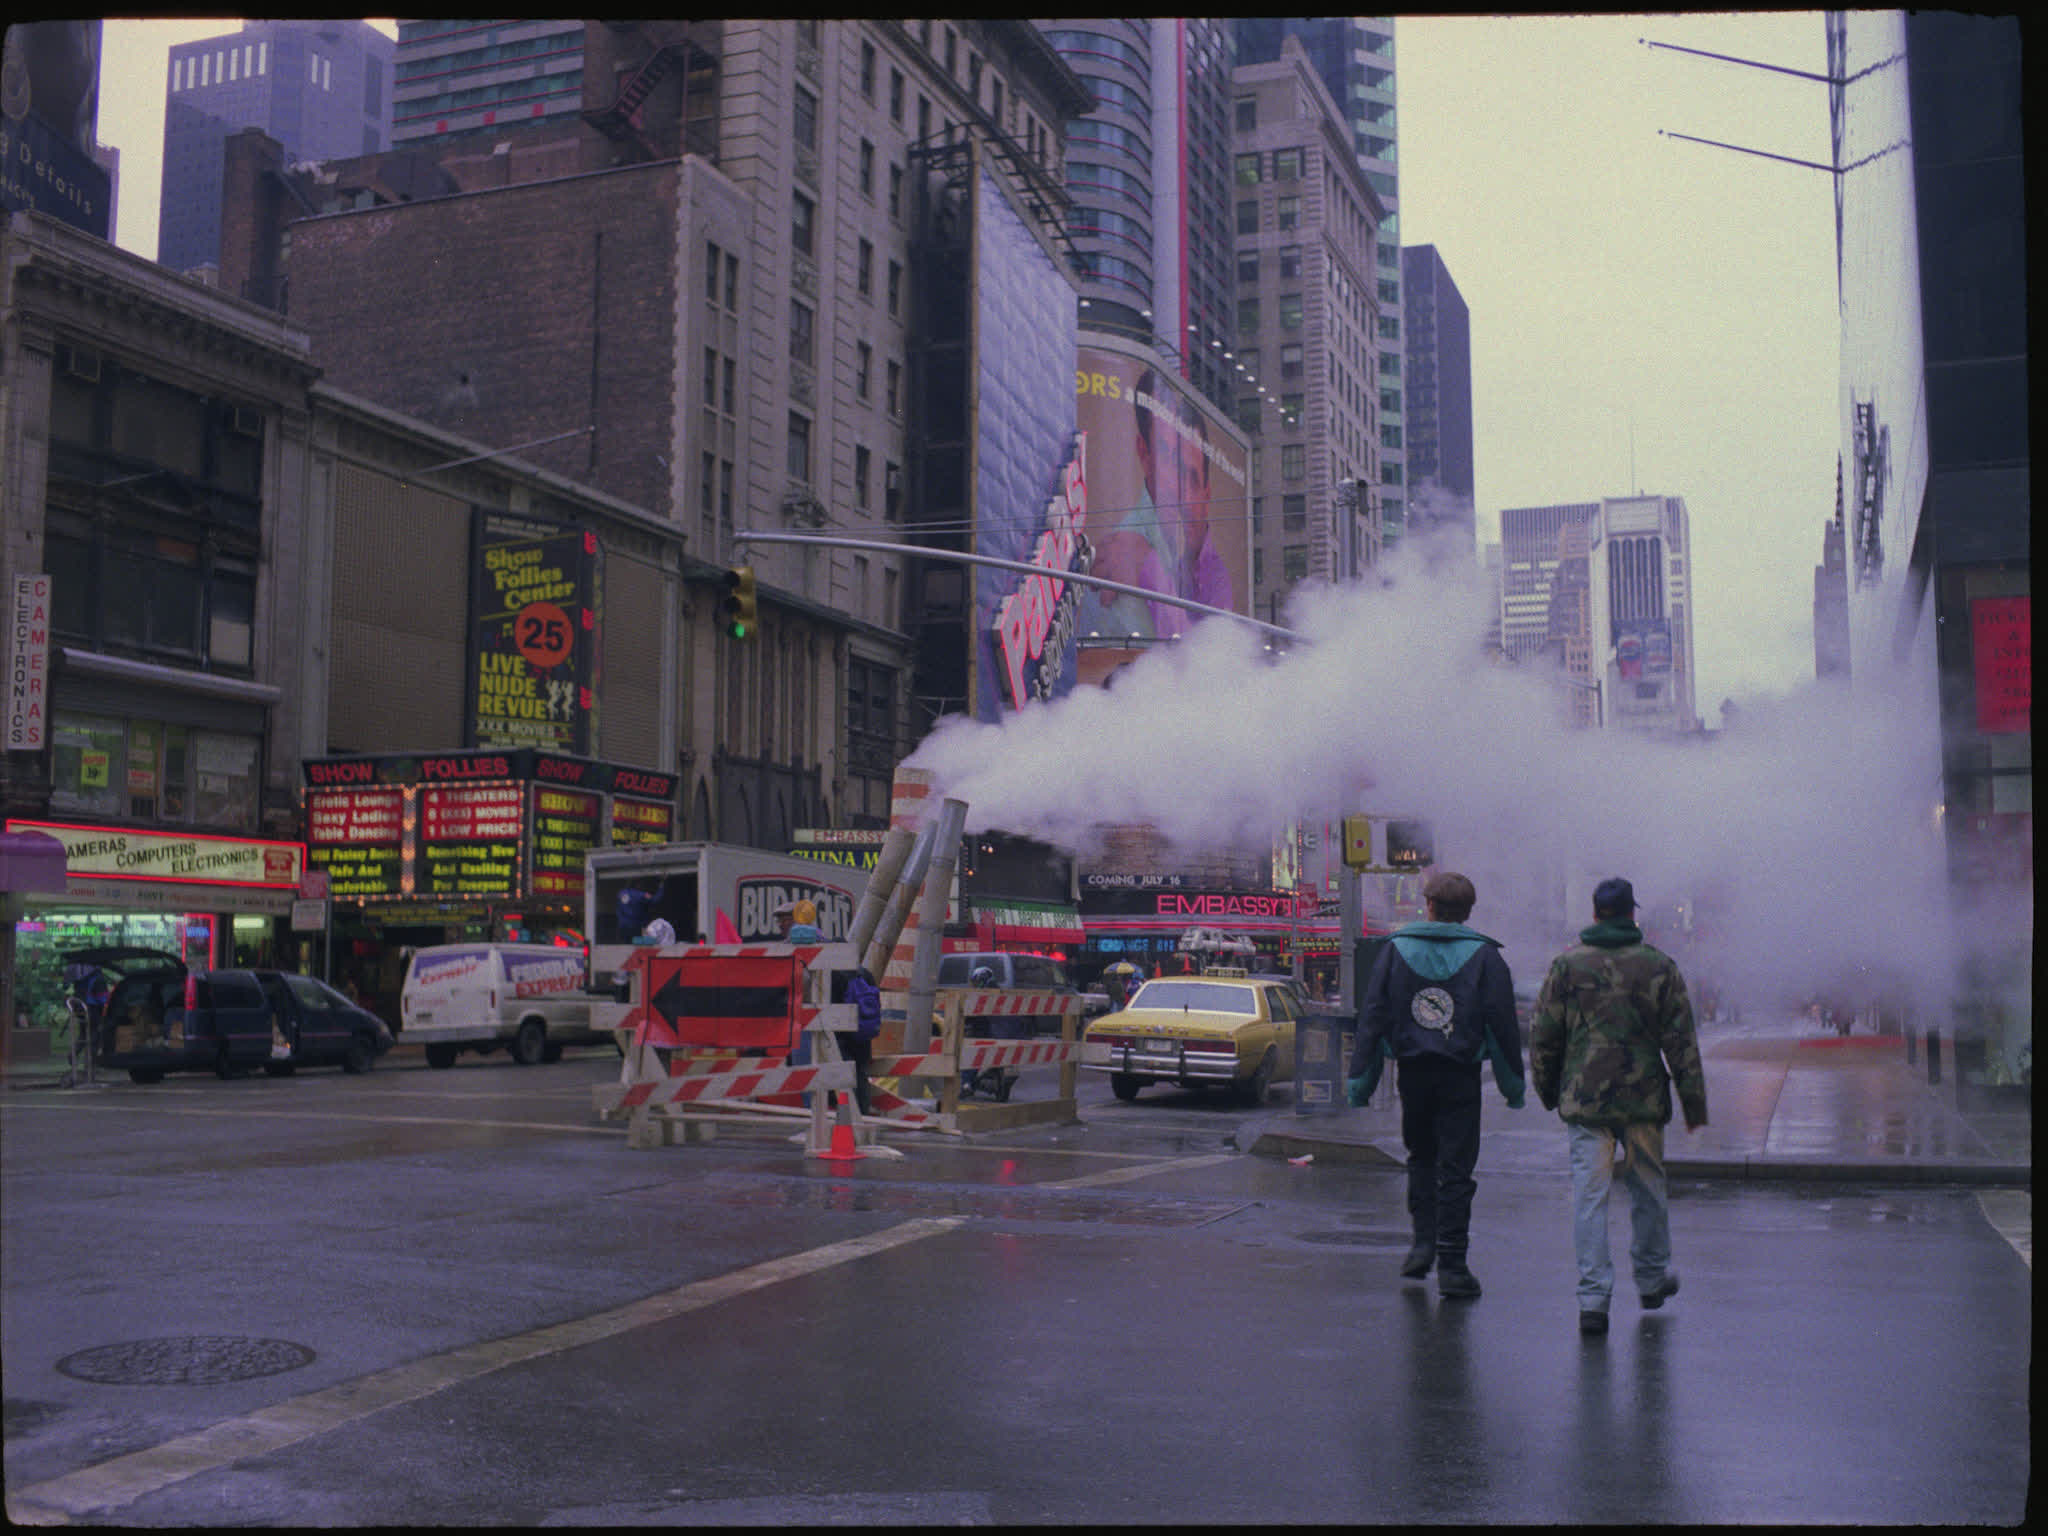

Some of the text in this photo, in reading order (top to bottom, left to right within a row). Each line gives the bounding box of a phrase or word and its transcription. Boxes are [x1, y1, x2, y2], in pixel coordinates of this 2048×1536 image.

[485, 548, 543, 571] Show
[494, 565, 562, 591] Follies
[504, 582, 575, 610] Center
[523, 618, 563, 651] 25
[12, 580, 30, 743] ELECTRONICS
[28, 580, 46, 743] CAMERAS
[479, 652, 526, 677] LIVE
[479, 674, 537, 698] NUDE
[477, 694, 547, 720] REVUE
[477, 718, 555, 739] XXX MOVIES
[311, 757, 509, 783] SHOW FOLLIES
[536, 759, 670, 795] SHOW FOLLIES
[446, 788, 518, 803] THEATERS
[613, 801, 669, 824] FOLLIES
[814, 830, 885, 842] EMBASSY
[66, 837, 259, 874] AMERAS COMPUTERS ELECTRONICS
[1088, 874, 1182, 886] COMING JULY 16
[791, 887, 851, 941] GHT
[1157, 894, 1279, 917] EMBASSY
